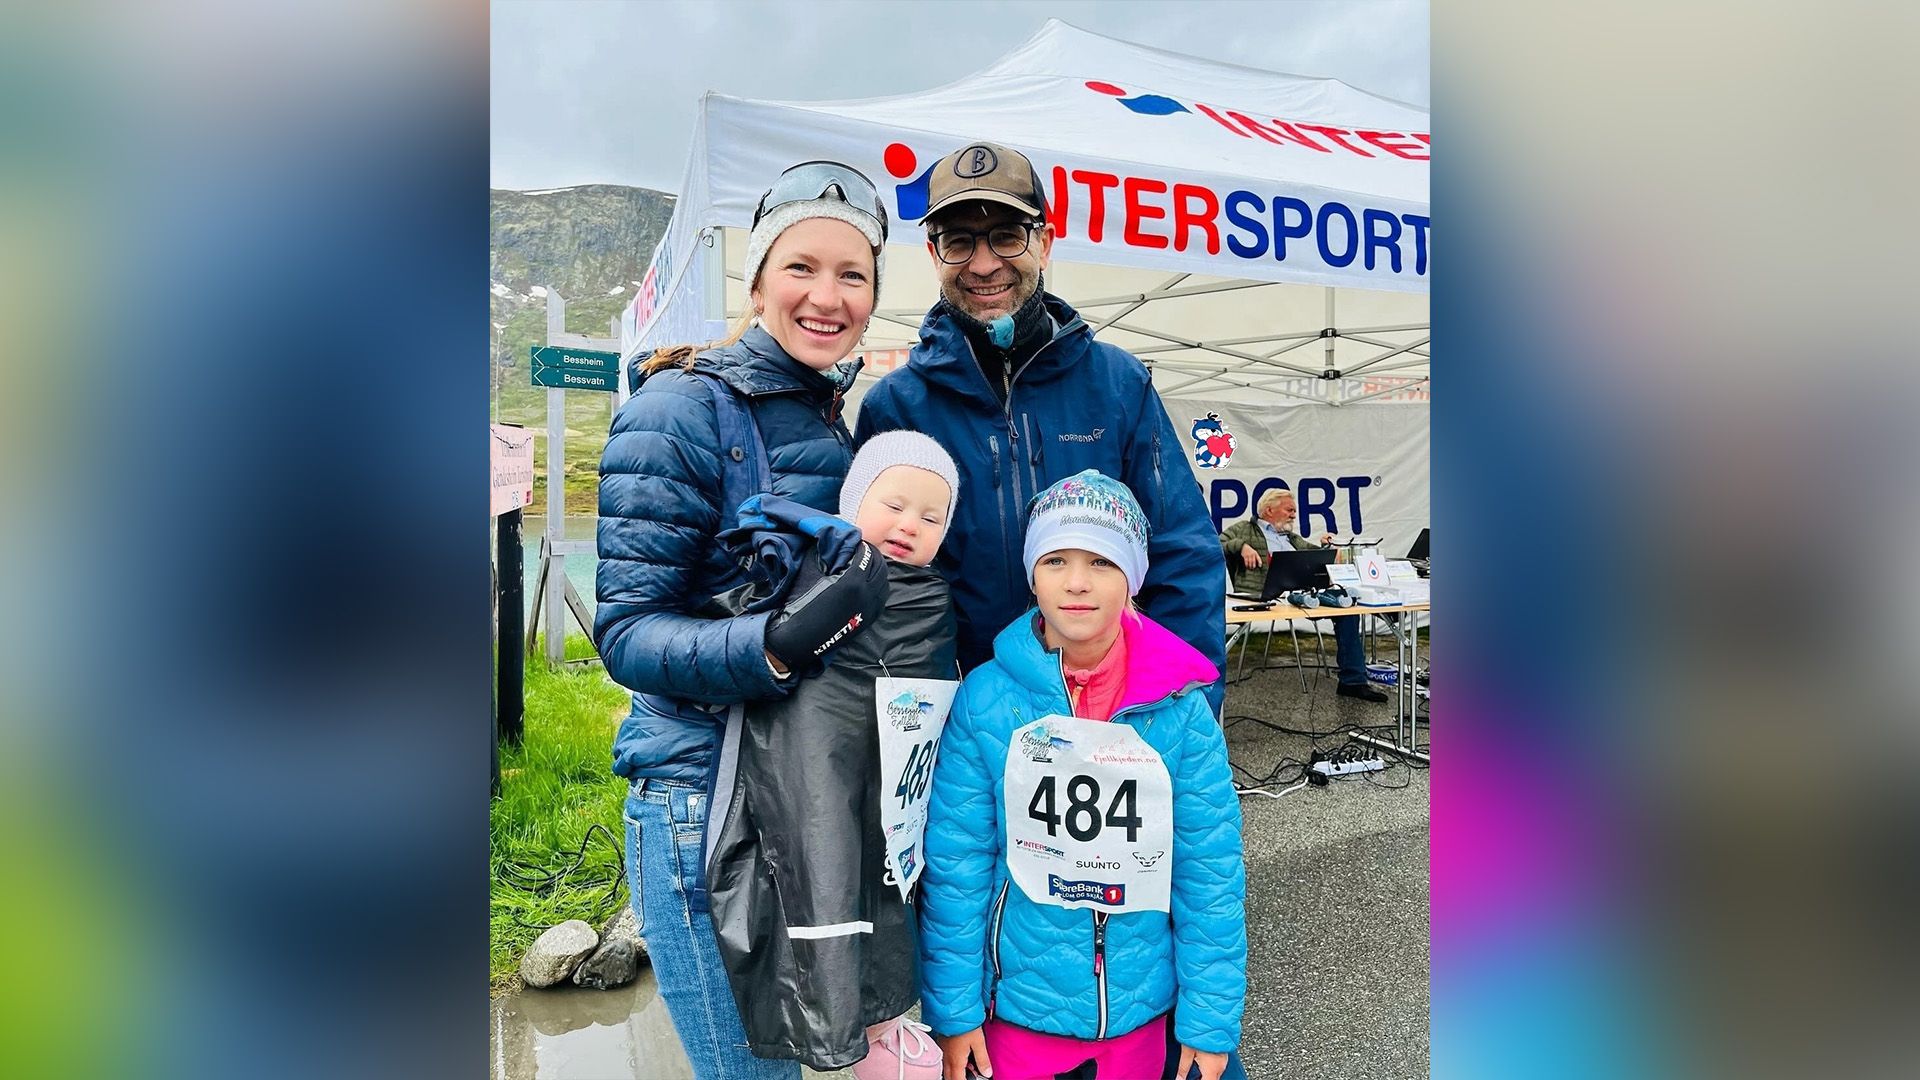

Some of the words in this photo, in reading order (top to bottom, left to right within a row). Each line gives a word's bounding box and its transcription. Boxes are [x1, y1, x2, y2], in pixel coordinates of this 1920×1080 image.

[1195, 104, 1430, 160] INTE
[563, 354, 604, 367] Bessheim
[564, 374, 605, 386] Bessvatn
[1197, 476, 1372, 538] PORT
[1093, 754, 1157, 765] Fjellkjeden.no
[1028, 774, 1143, 842] 484
[1023, 841, 1065, 857] INTERSPORT
[1075, 860, 1121, 870] SUUNTO
